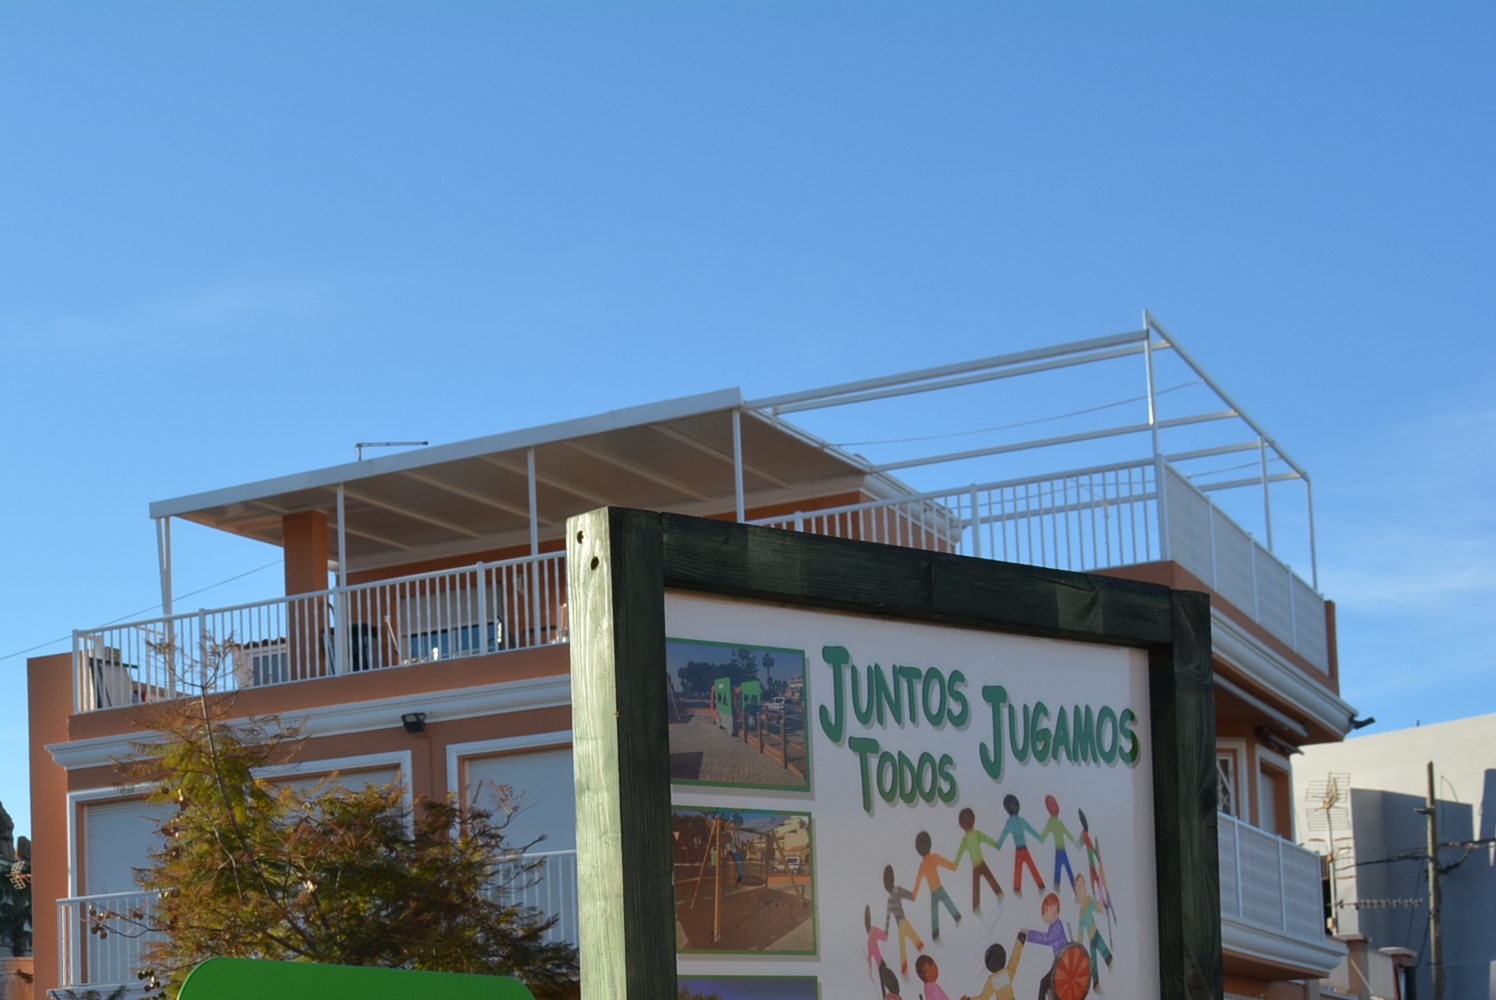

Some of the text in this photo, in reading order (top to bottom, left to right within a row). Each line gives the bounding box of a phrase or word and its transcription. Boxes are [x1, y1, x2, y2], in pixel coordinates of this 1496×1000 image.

[819, 645, 1139, 780] JUNTOS JUGAMOS
[848, 736, 957, 813] TODOS
